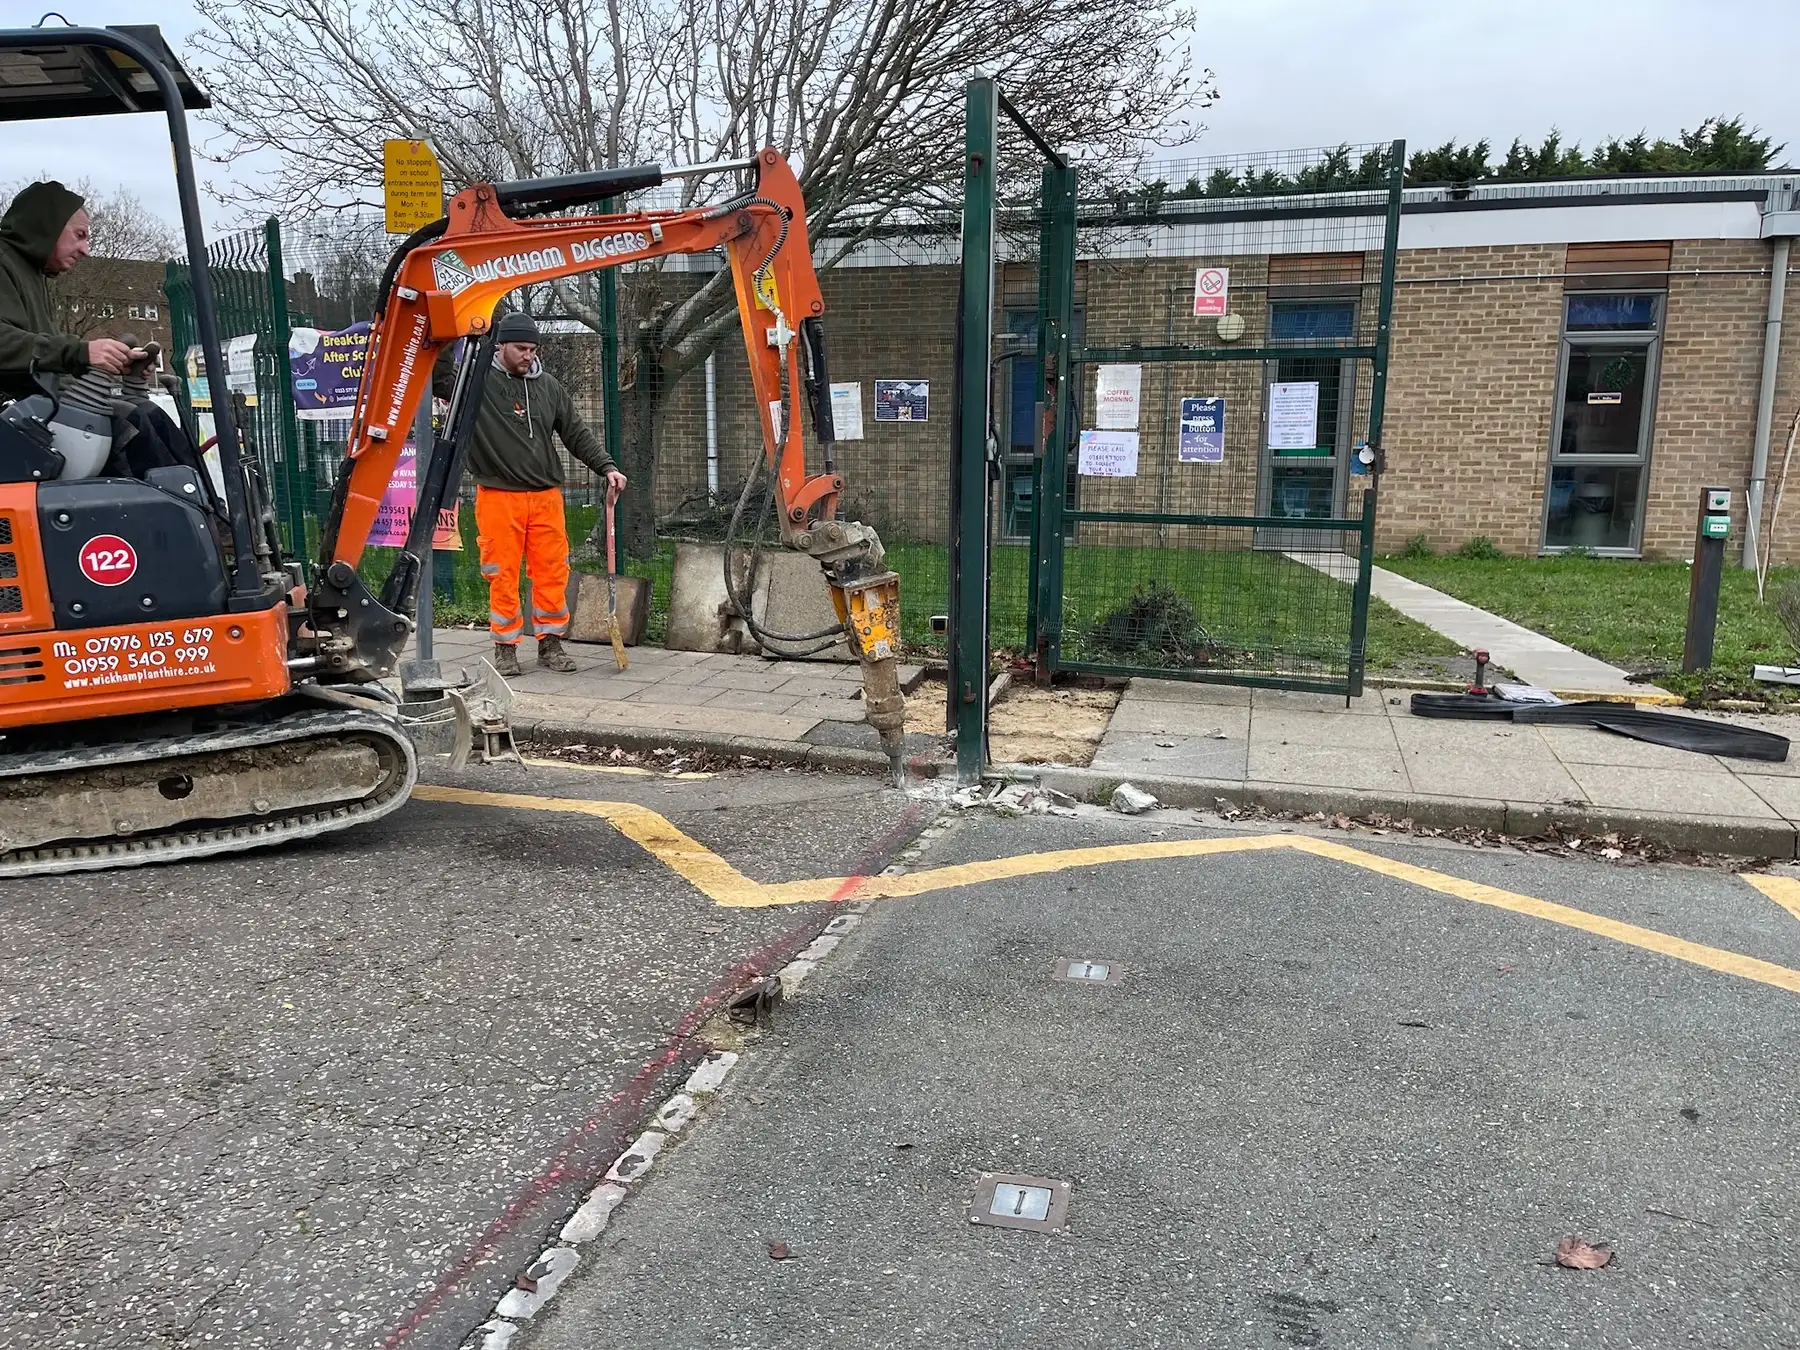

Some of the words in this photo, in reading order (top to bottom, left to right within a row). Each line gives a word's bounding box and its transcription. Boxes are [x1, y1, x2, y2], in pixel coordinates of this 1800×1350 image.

[407, 159, 432, 167] stopping
[471, 246, 566, 283] WICKHAM
[570, 231, 650, 264] DIGGERS
[324, 350, 350, 363] After
[386, 313, 428, 426] www.wickhamplanthire.co.uk
[1191, 404, 1216, 412] Please
[86, 550, 131, 572] 122
[52, 641, 77, 658] M:
[85, 635, 142, 654] 07976
[149, 632, 175, 647] 125
[183, 628, 214, 643] 679
[64, 655, 119, 674] 01959
[128, 650, 166, 668] 540
[174, 646, 209, 662] 999
[63, 662, 216, 689] www.wickhamplanthire.co.uk
